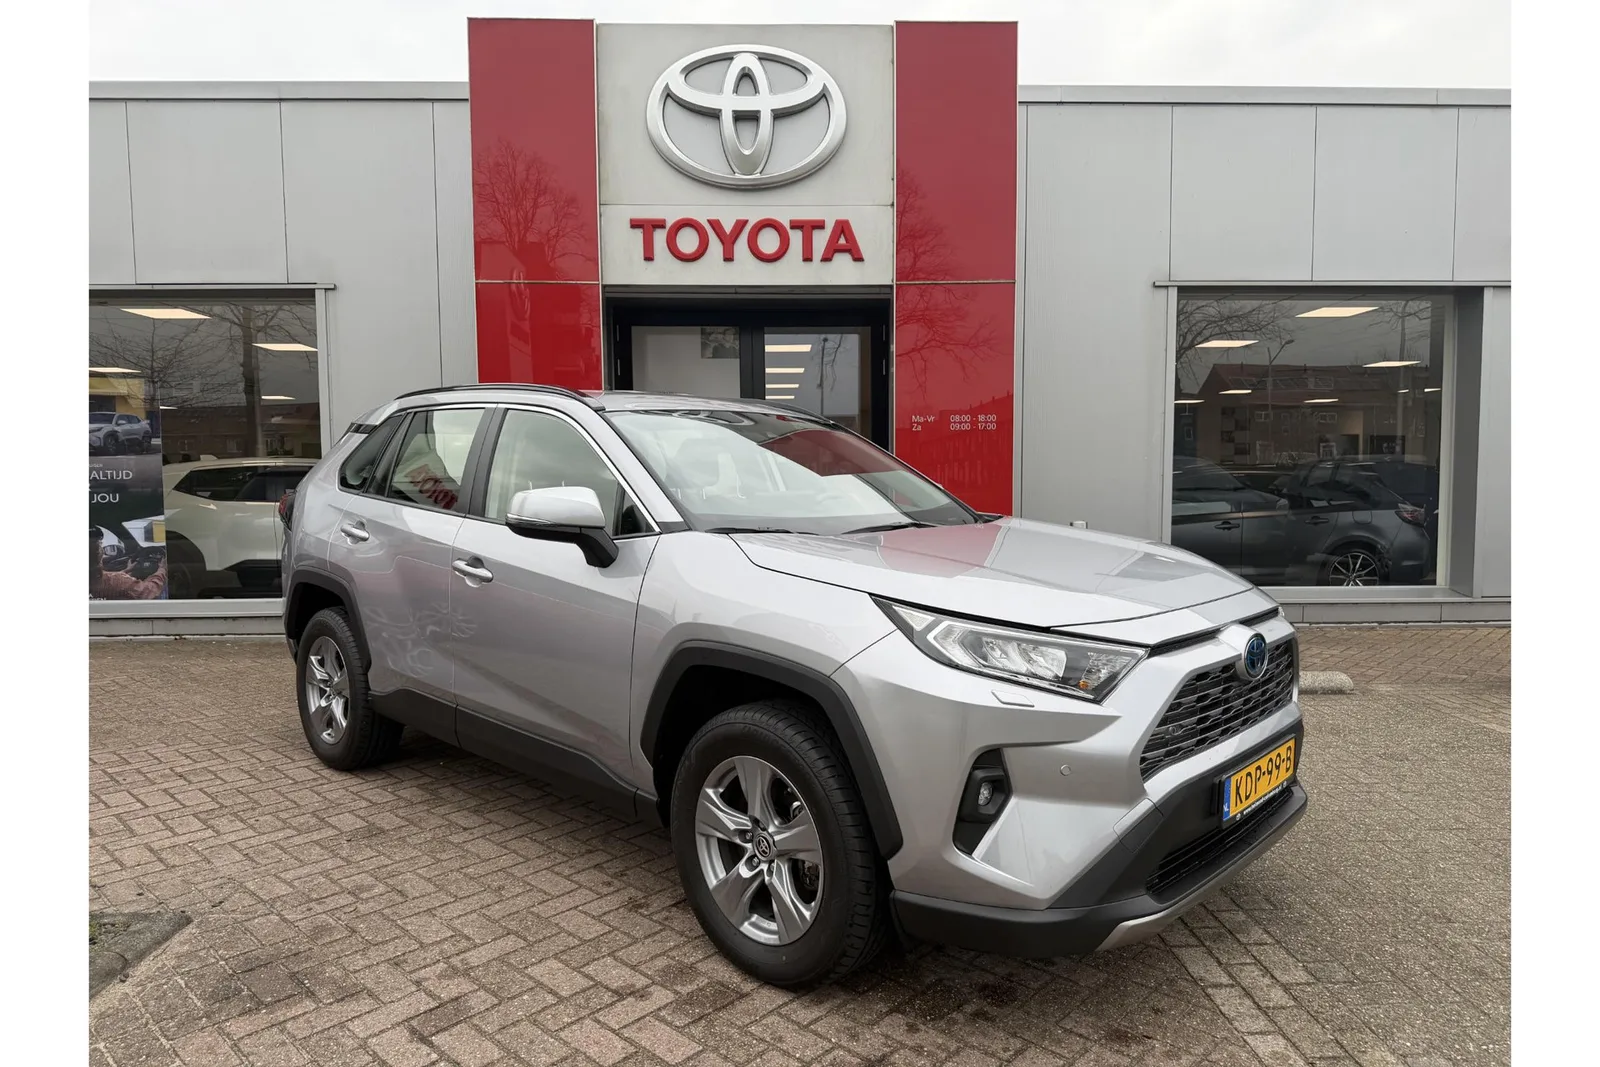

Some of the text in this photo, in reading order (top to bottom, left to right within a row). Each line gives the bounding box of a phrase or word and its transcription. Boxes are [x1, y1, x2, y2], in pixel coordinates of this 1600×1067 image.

[629, 217, 864, 262] TOYOTA
[911, 415, 935, 423] Ma-Vr
[950, 414, 971, 422] 08:00
[977, 414, 997, 422] 18:00
[912, 423, 922, 431] Za
[950, 423, 971, 431] 09:00
[90, 470, 133, 480] ALTIJD
[91, 493, 120, 503] JOU
[1234, 745, 1293, 808] KDP-99-B
